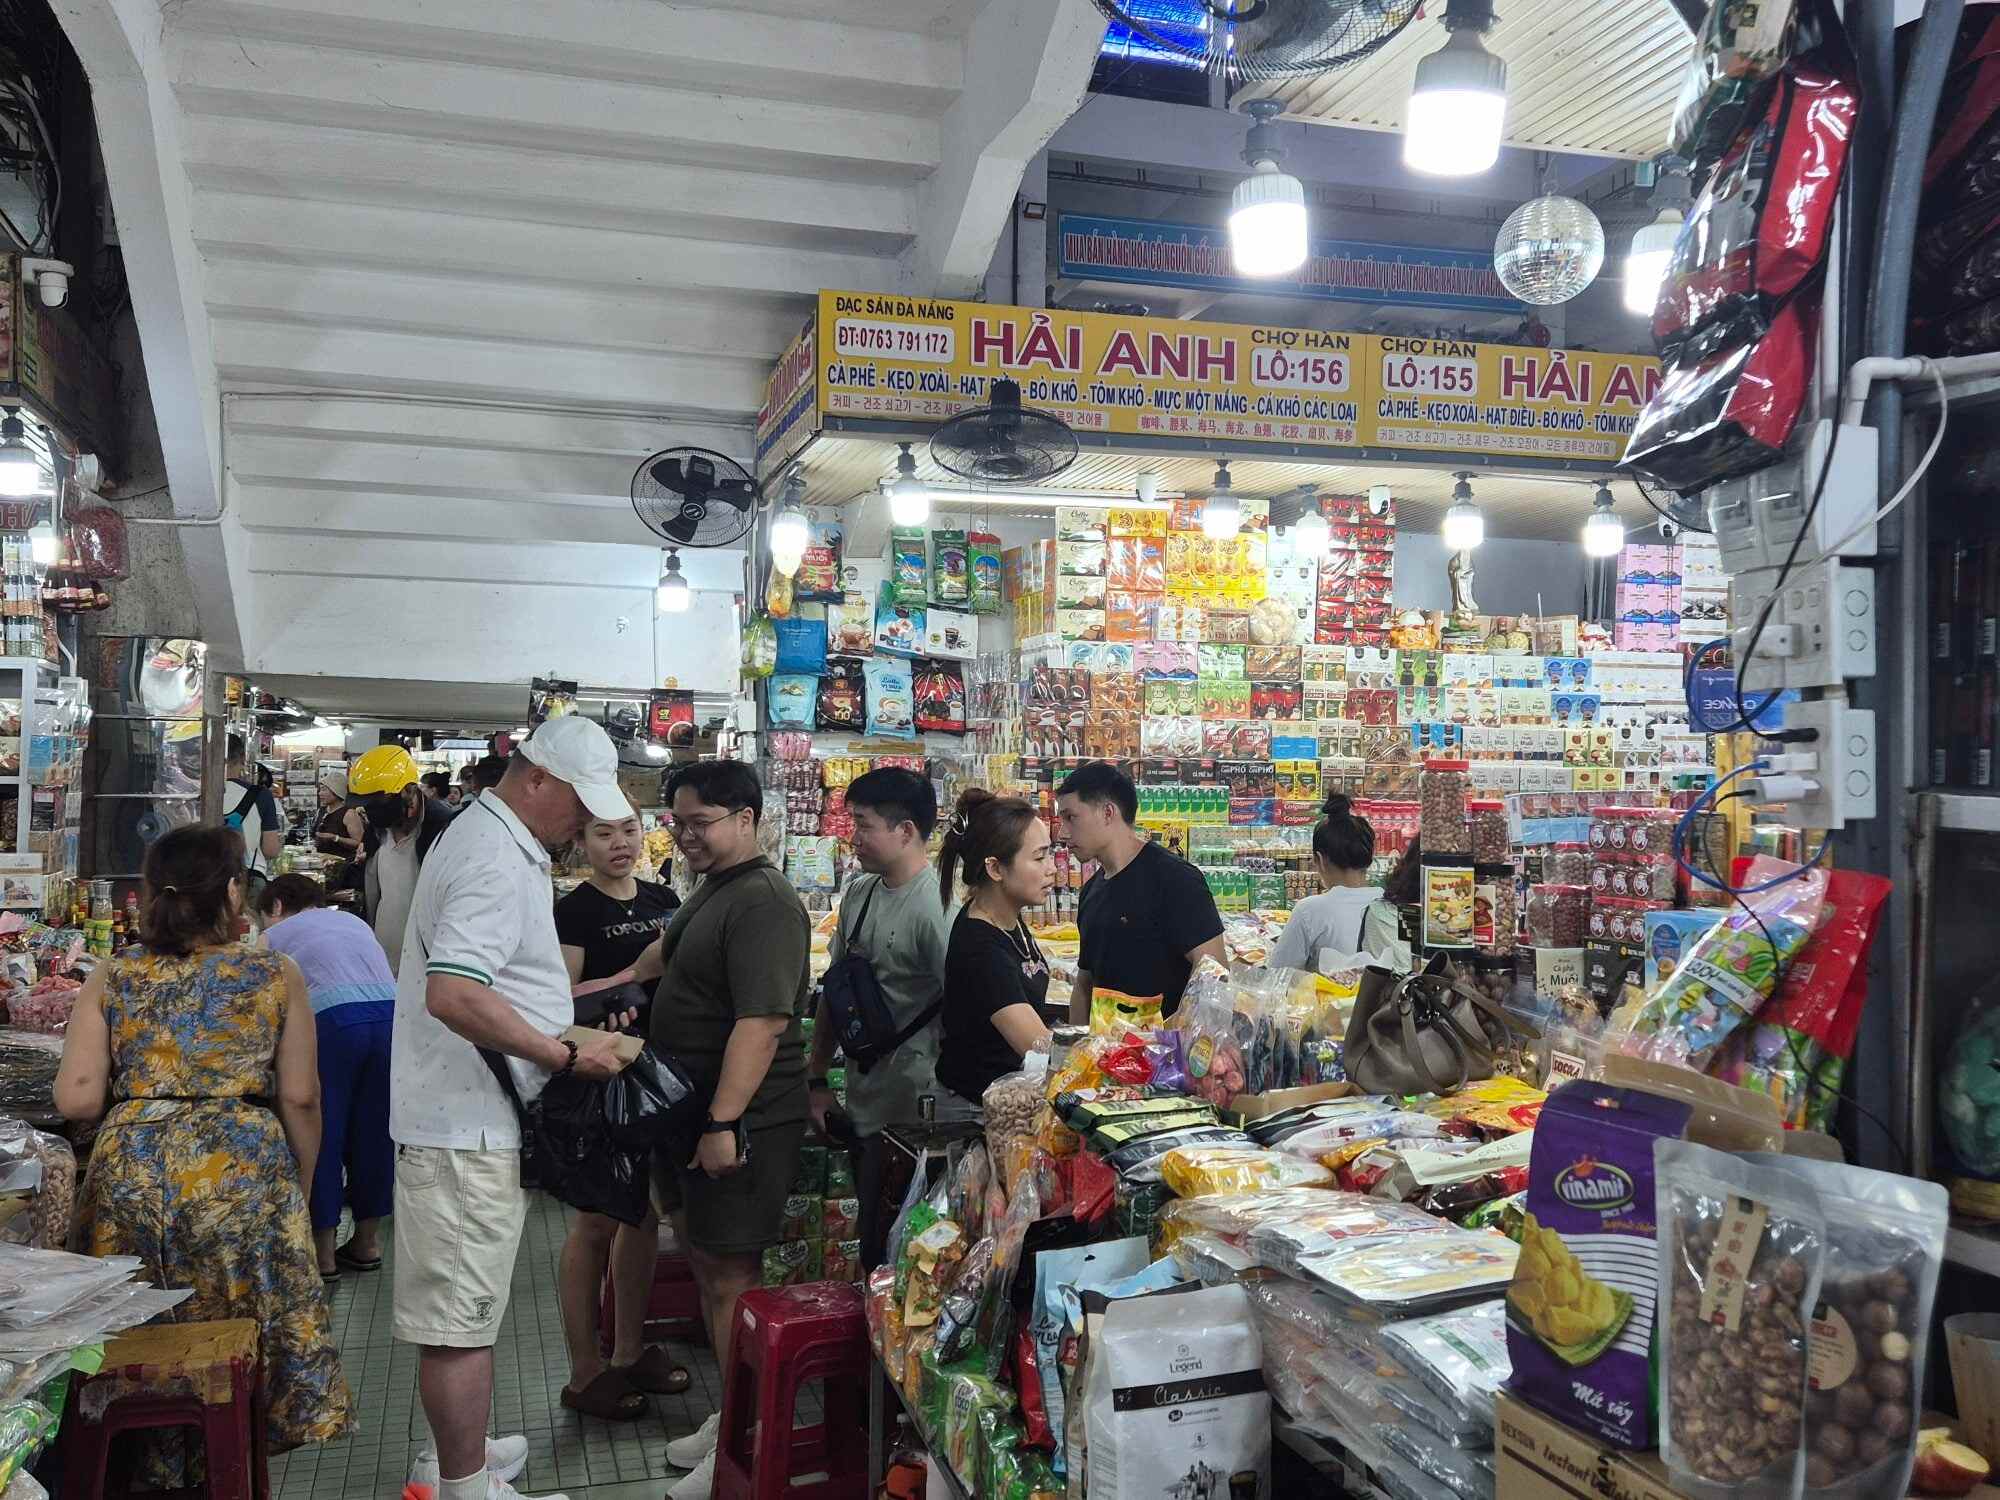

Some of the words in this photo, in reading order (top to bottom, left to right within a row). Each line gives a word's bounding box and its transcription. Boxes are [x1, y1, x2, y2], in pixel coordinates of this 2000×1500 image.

[897, 331, 920, 352] 791
[925, 332, 947, 354] 172
[972, 312, 1081, 371] HẢI
[1098, 330, 1237, 382] ANH
[1251, 329, 1299, 349] CHỢ
[1305, 331, 1350, 350] HÀN
[1433, 340, 1477, 358] HÀN
[1256, 350, 1343, 385] LÔ:156
[1387, 356, 1473, 392] LÔ:155
[1502, 352, 1591, 403] HẢI
[827, 359, 847, 385] CÀ
[849, 362, 875, 387] PHÊ
[887, 369, 914, 395] KẸO
[919, 367, 949, 393] XOÀI
[960, 375, 985, 400] HẠT
[1029, 376, 1048, 401] BÒ
[1051, 377, 1078, 402] KHÔ
[1089, 380, 1116, 404] TÔM
[1427, 402, 1451, 426] KẸO
[1452, 400, 1478, 423] XOÀI
[1486, 407, 1508, 429] HẠT
[1283, 815, 1311, 823] Colgate
[1169, 1359, 1203, 1374] Legend
[1153, 1384, 1228, 1407] Classic
